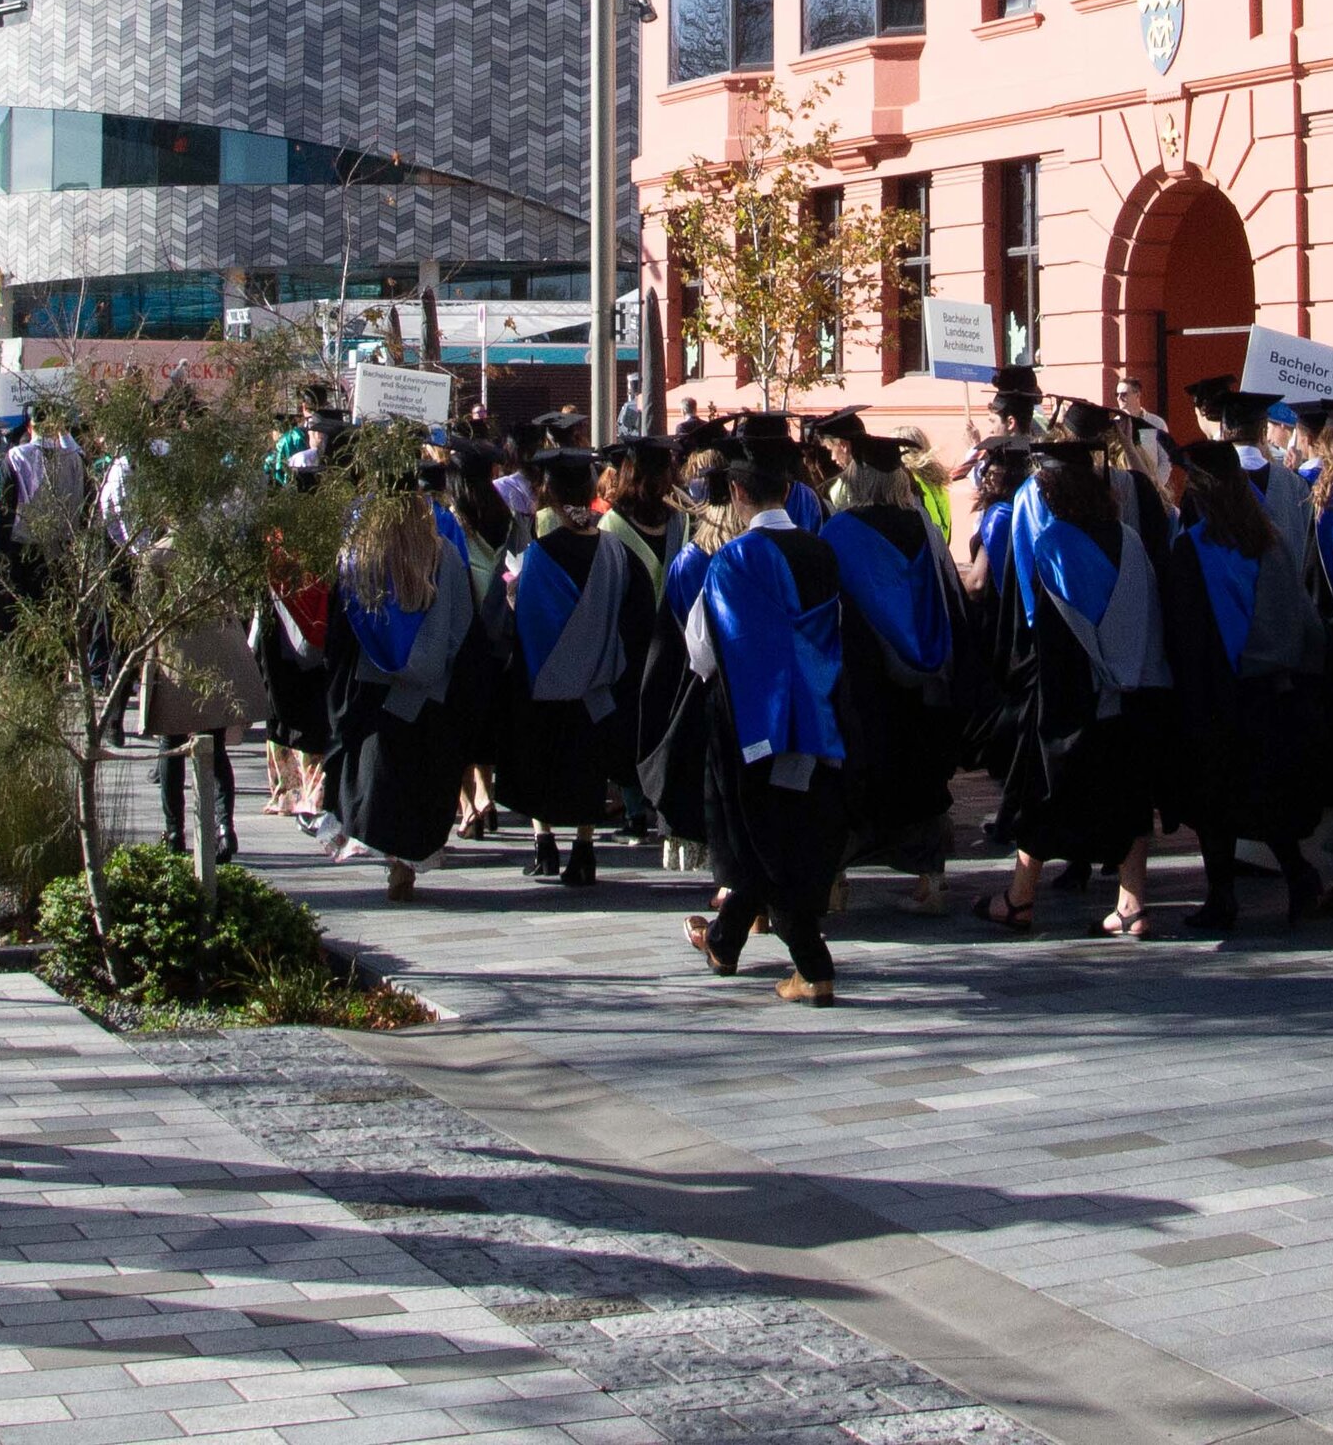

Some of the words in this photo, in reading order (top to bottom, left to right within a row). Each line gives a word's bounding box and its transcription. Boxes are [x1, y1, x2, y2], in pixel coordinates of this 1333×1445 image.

[942, 312, 971, 325] Bachelor
[972, 317, 980, 326] of
[945, 327, 980, 340] Landscape
[943, 340, 984, 353] Architecture
[1270, 351, 1329, 378] Bachelor
[363, 370, 393, 381] Bachelor
[403, 375, 446, 388] Environment
[1278, 369, 1332, 395] Science
[396, 383, 420, 392] Society
[384, 393, 413, 403] Bachelor
